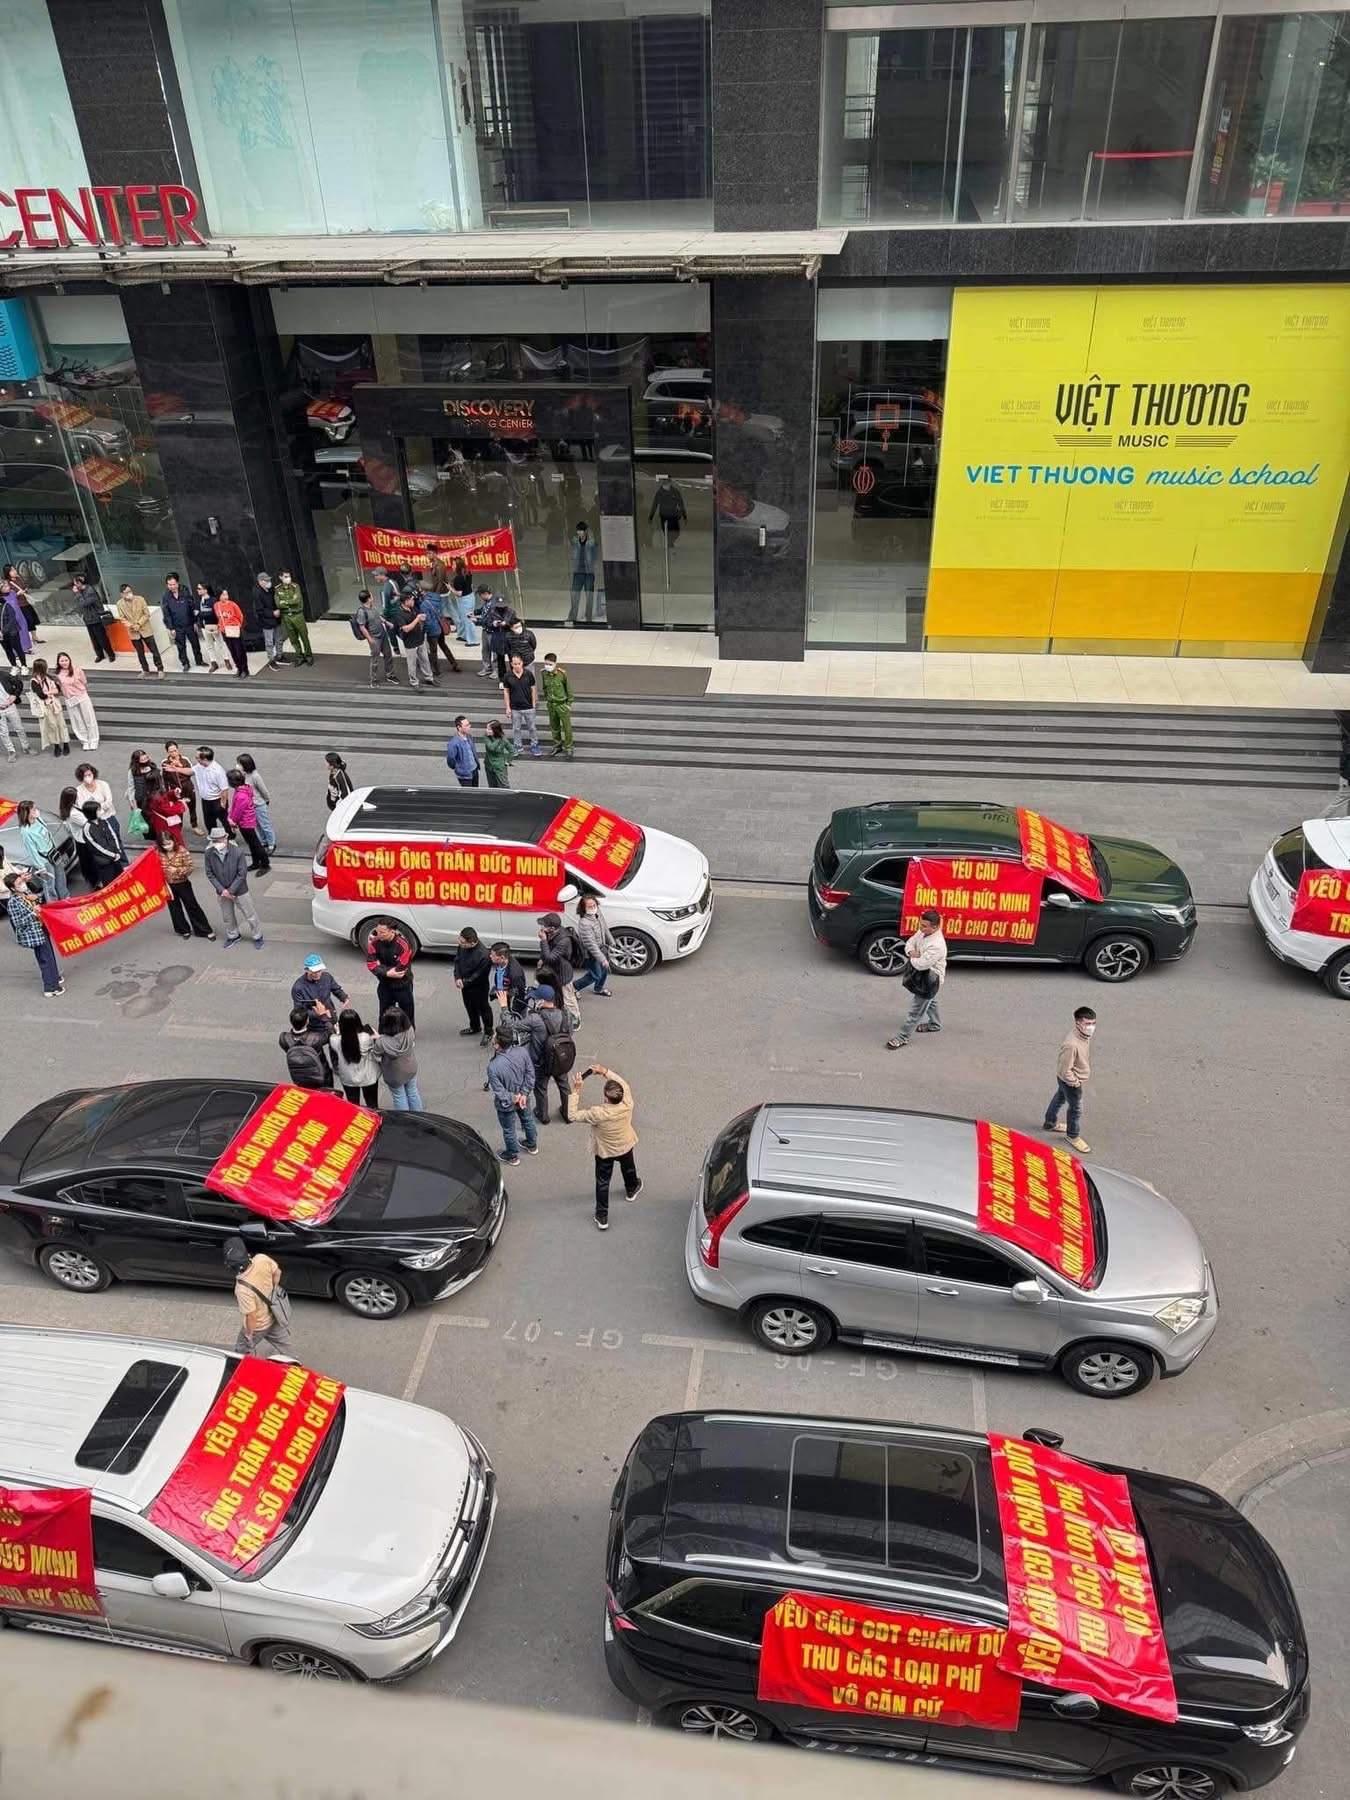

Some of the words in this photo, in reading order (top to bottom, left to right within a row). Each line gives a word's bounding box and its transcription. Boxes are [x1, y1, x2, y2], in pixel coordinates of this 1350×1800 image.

[443, 399, 535, 417] DISCOVERY
[1055, 374, 1120, 432] VIỆT
[1132, 383, 1250, 426] THƯƠNG
[1118, 434, 1169, 448] MUSIC
[967, 465, 1022, 484] VIET
[1028, 465, 1135, 485] THUONG
[1146, 464, 1223, 486] music
[1229, 463, 1320, 485] school
[333, 847, 360, 867] YÊU
[364, 846, 395, 869] CẦU
[400, 846, 431, 870] ÔNG
[436, 848, 475, 872] TRẦN
[480, 850, 511, 874] ĐỨC
[516, 856, 558, 877] MINH
[952, 858, 973, 880] YÊU
[975, 859, 999, 881] CẦU
[76, 901, 106, 926] CÔNG
[104, 888, 131, 911] KHAI
[129, 880, 146, 898] VÀ
[357, 877, 385, 897] TRẢ
[415, 875, 433, 900] ĐỎ
[440, 881, 470, 902] CHO
[475, 883, 496, 903] CƯ
[502, 881, 533, 905] DÂN
[915, 883, 937, 906] ÔNG
[941, 886, 970, 909] TRẦN
[973, 887, 996, 910] ĐỨC
[1000, 892, 1030, 912] MINH
[1308, 874, 1342, 899] YÊU
[60, 933, 83, 953] TRẢ
[905, 916, 921, 931] TR
[946, 914, 962, 934] ĐỎ
[965, 920, 988, 936] CHO
[991, 921, 1008, 938] CƯ
[1010, 918, 1035, 939] DÂN
[221, 1164, 252, 1187] YÊU
[986, 1199, 1015, 1226] YÊU
[203, 1421, 239, 1457] YÊU
[224, 1387, 258, 1423] CẦU
[200, 1488, 244, 1532] ÔNG
[229, 1438, 271, 1487] TRẦN
[256, 1403, 290, 1441] ĐỨC
[1001, 1440, 1038, 1478] DỨT
[231, 1519, 269, 1561] TRẢ
[270, 1461, 298, 1493] ĐỎ
[286, 1427, 317, 1464] CHO
[304, 1400, 329, 1428] CƯ
[1050, 1478, 1090, 1516] PHÍ
[1003, 1477, 1048, 1537] CHẤM
[1065, 1514, 1098, 1564] LOẠI
[30, 1544, 78, 1579] MINH
[1021, 1539, 1054, 1580] CĐT
[1069, 1563, 1105, 1610] CÁC
[1111, 1557, 1148, 1603] CĂN
[774, 1598, 808, 1629] YÊU
[814, 1609, 855, 1636] CẦU
[861, 1619, 902, 1644] CĐT
[1022, 1581, 1060, 1632] CẦU
[1115, 1603, 1153, 1637] VÔ
[1017, 1632, 1063, 1674] YÊU
[1076, 1610, 1109, 1659] THU
[801, 1643, 840, 1670] THU
[846, 1648, 887, 1678] CÁC
[893, 1660, 939, 1689] LOẠI
[946, 1663, 984, 1694] PHÍ
[832, 1683, 858, 1706] VÔ
[865, 1687, 906, 1716] CĂN
[913, 1693, 944, 1719] CỨ
